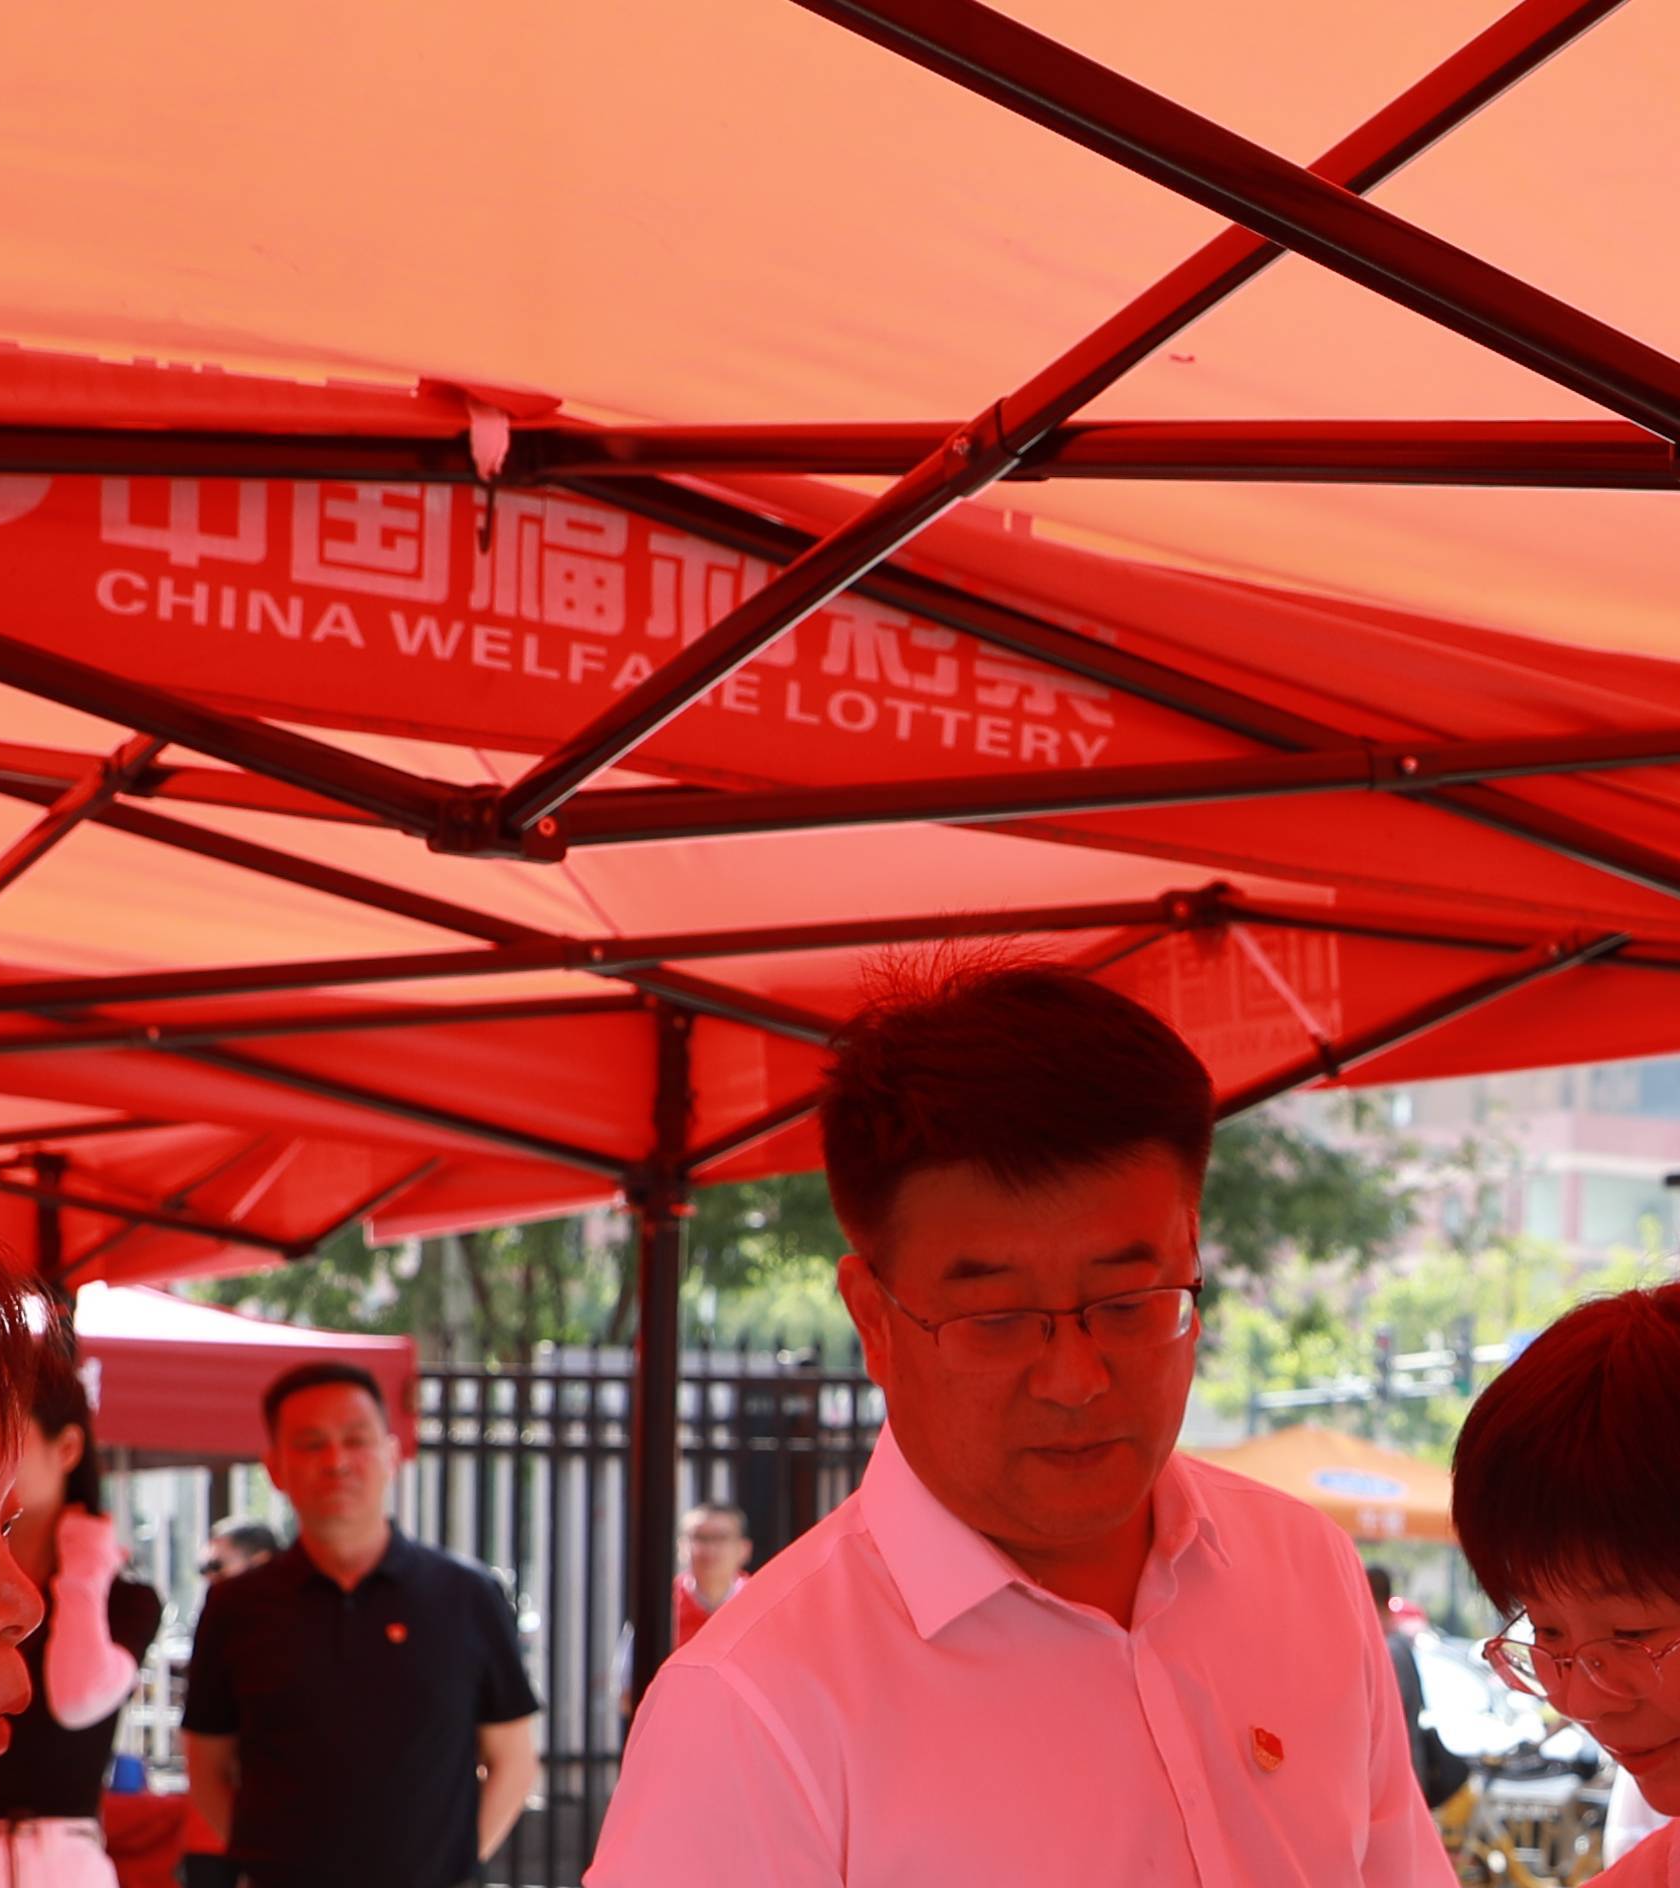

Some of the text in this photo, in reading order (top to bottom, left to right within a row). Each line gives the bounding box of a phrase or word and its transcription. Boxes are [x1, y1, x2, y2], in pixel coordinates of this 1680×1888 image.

[96, 569, 1108, 768] CHINA WELFAE LOTTERY
